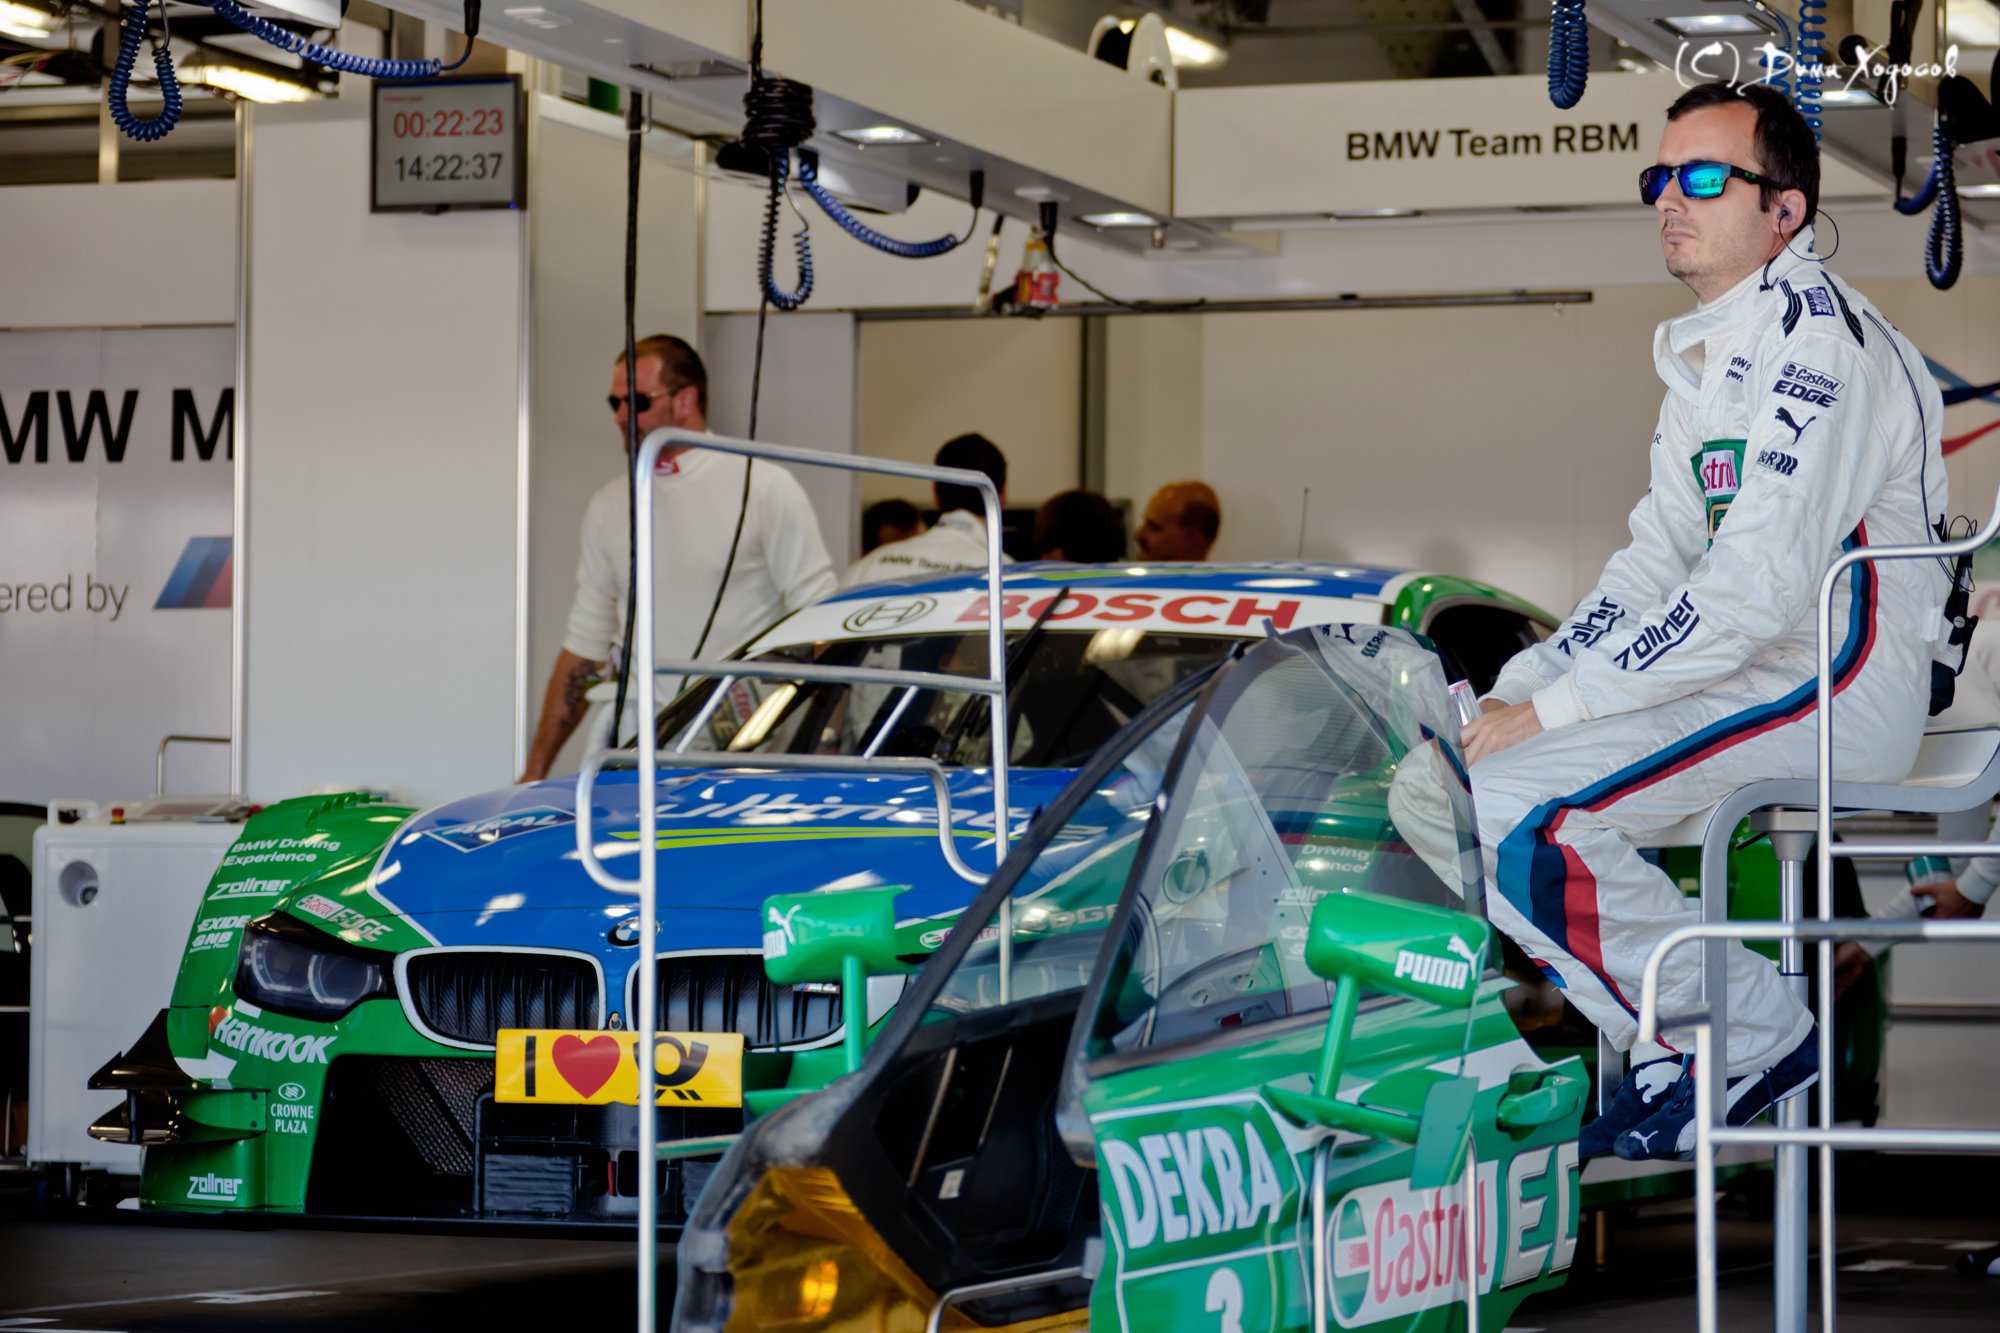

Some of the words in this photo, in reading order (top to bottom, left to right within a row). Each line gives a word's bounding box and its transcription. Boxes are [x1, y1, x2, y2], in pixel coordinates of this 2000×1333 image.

[393, 107, 503, 138] 00:22:23
[1347, 130, 1440, 160] BMW
[1448, 129, 1541, 157] Team
[1553, 123, 1638, 153] RBM
[395, 153, 502, 181] 14:22:37
[1796, 368, 1839, 392] Castrol
[1772, 380, 1839, 408] EDGE
[86, 573, 129, 621] by
[954, 593, 1301, 630] BOSCH
[231, 839, 278, 853] BMW
[279, 838, 341, 852] Driving
[1301, 844, 1371, 861] Driving
[224, 851, 318, 867] Experience
[207, 878, 291, 901] zollner
[197, 915, 251, 933] EXIDE
[271, 1103, 314, 1119] CROWNE
[275, 1119, 308, 1134] PLAZA
[187, 1173, 243, 1201] zollner
[1101, 1121, 1282, 1249] DEKRA
